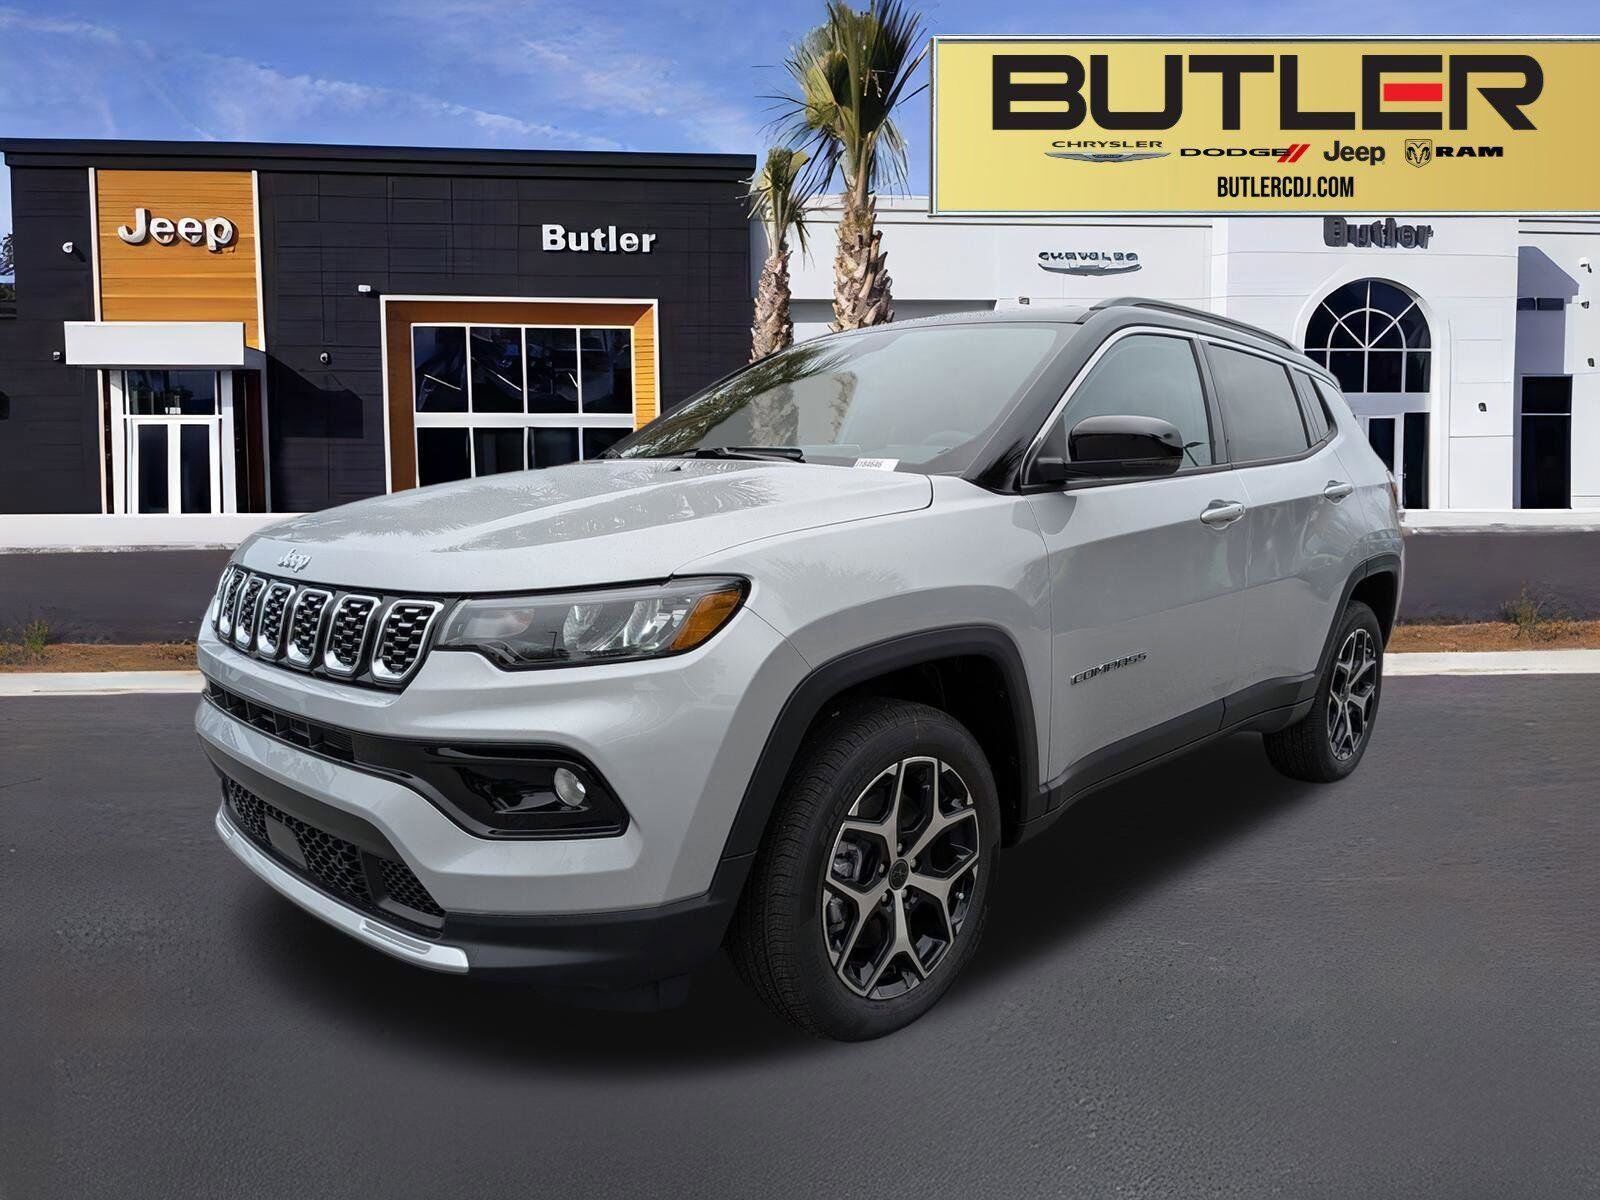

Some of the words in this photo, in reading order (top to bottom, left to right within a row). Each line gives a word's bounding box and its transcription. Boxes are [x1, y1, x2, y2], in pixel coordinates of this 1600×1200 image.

[117, 207, 236, 252] Jeep
[541, 223, 657, 253] Butler
[278, 548, 312, 573] Jeep
[1070, 652, 1148, 686] COMPASS
